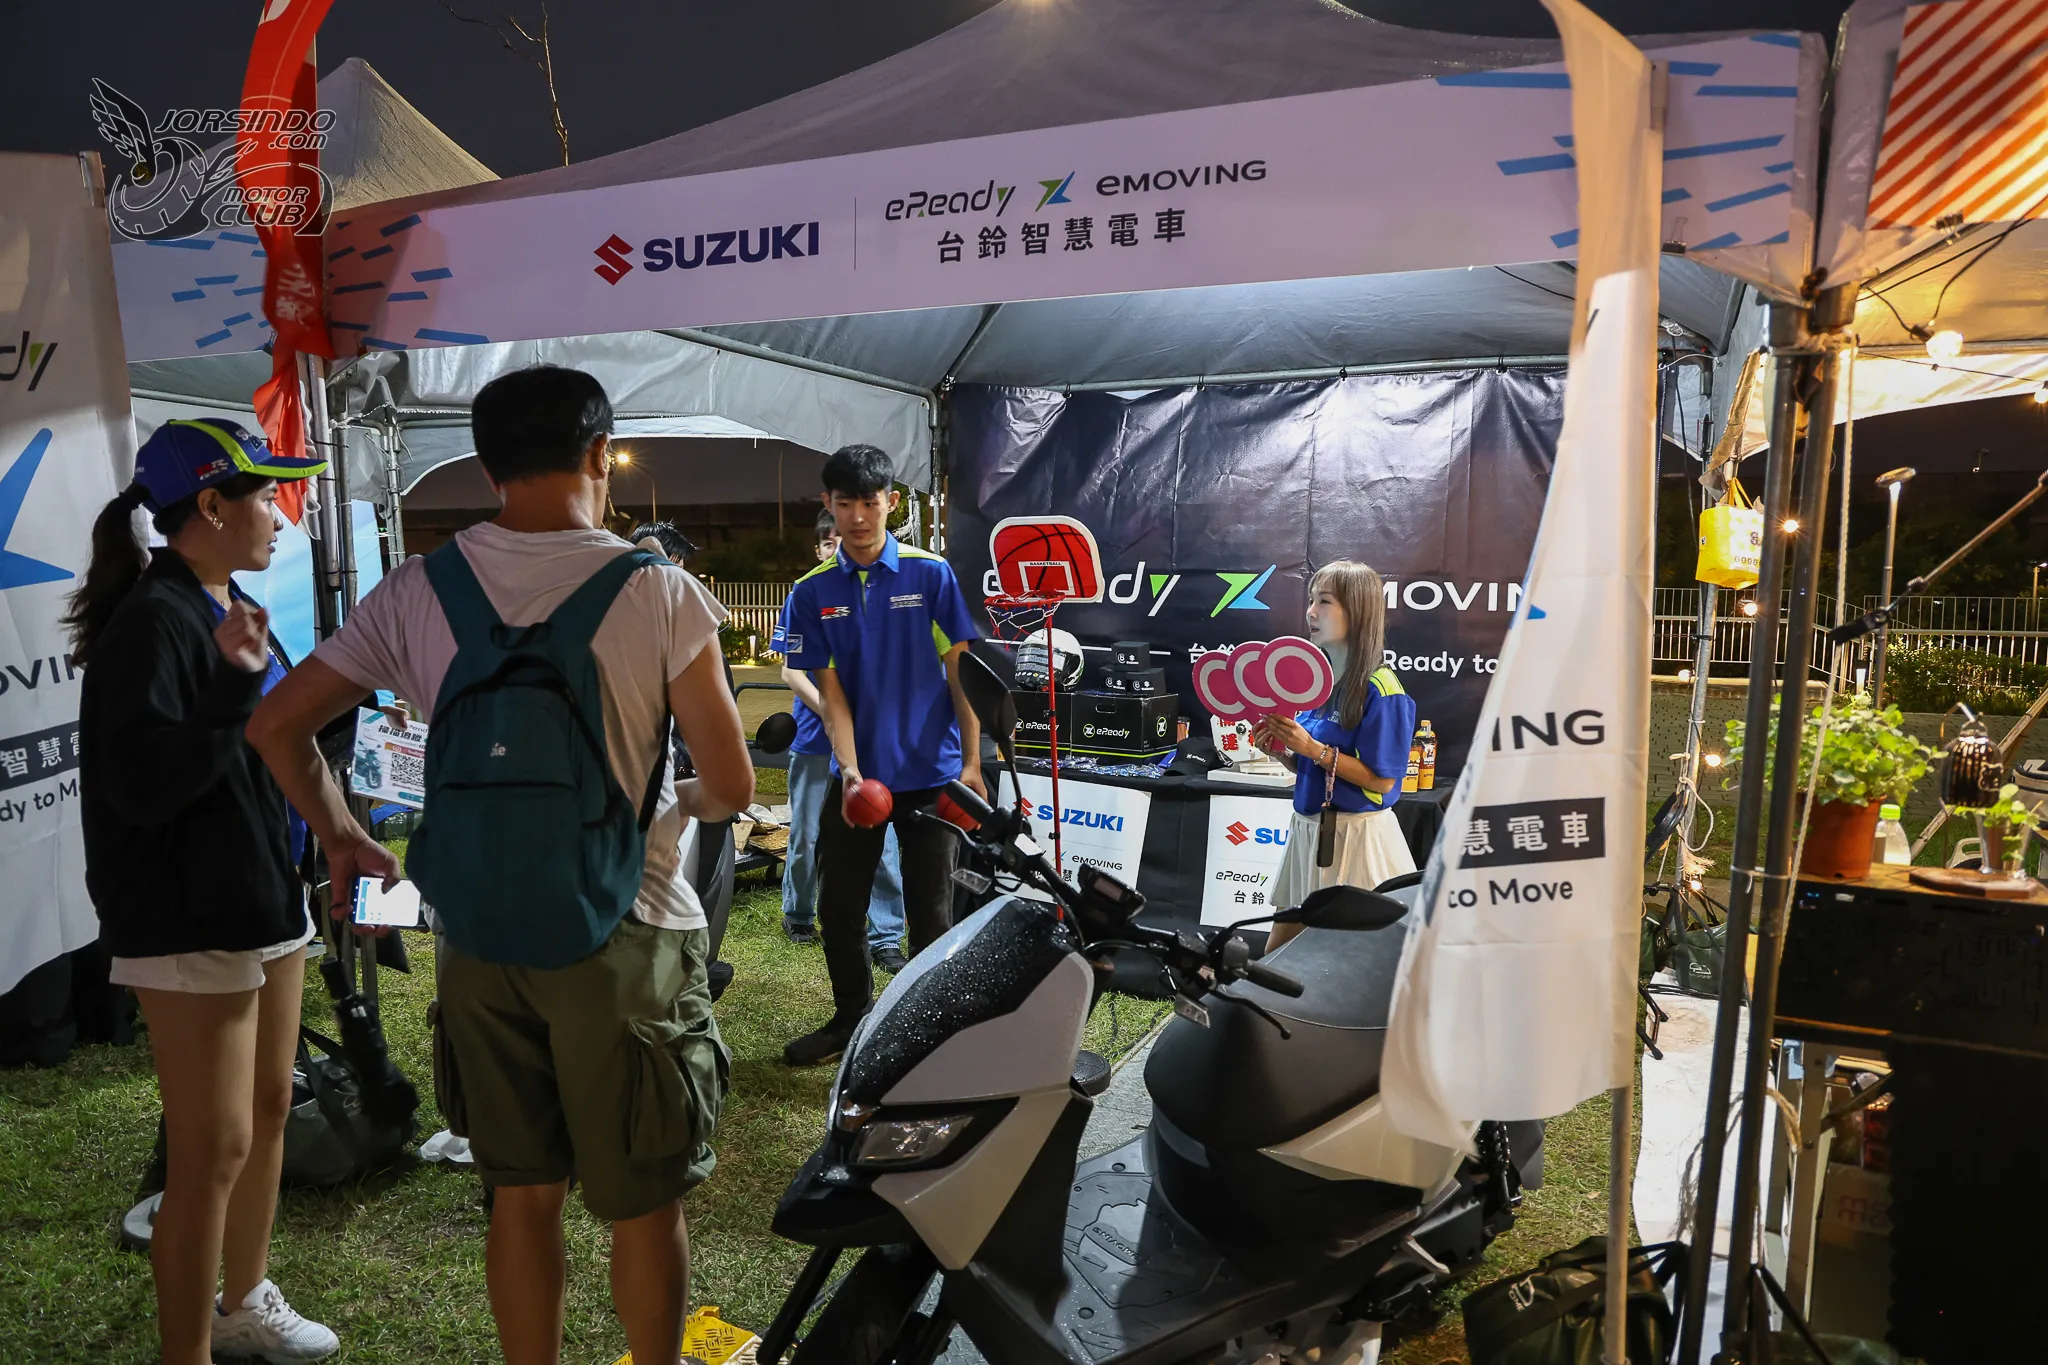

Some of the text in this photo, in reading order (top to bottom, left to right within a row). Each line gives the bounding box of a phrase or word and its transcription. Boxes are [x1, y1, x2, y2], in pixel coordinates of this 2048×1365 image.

[885, 160, 1267, 221] eReady eMOVING
[643, 221, 819, 272] SUZUKI
[937, 208, 1186, 264] 台鈴智慧電車
[1096, 728, 1130, 740] eReady
[33, 791, 55, 811] to
[60, 778, 81, 801] M
[1037, 804, 1124, 832] SUZUKI
[1460, 810, 1590, 856] 慧電車
[1072, 855, 1123, 871] eMOVING
[1215, 870, 1269, 887] eReady
[1488, 877, 1574, 906] Move
[1234, 890, 1265, 905] 台鈴
